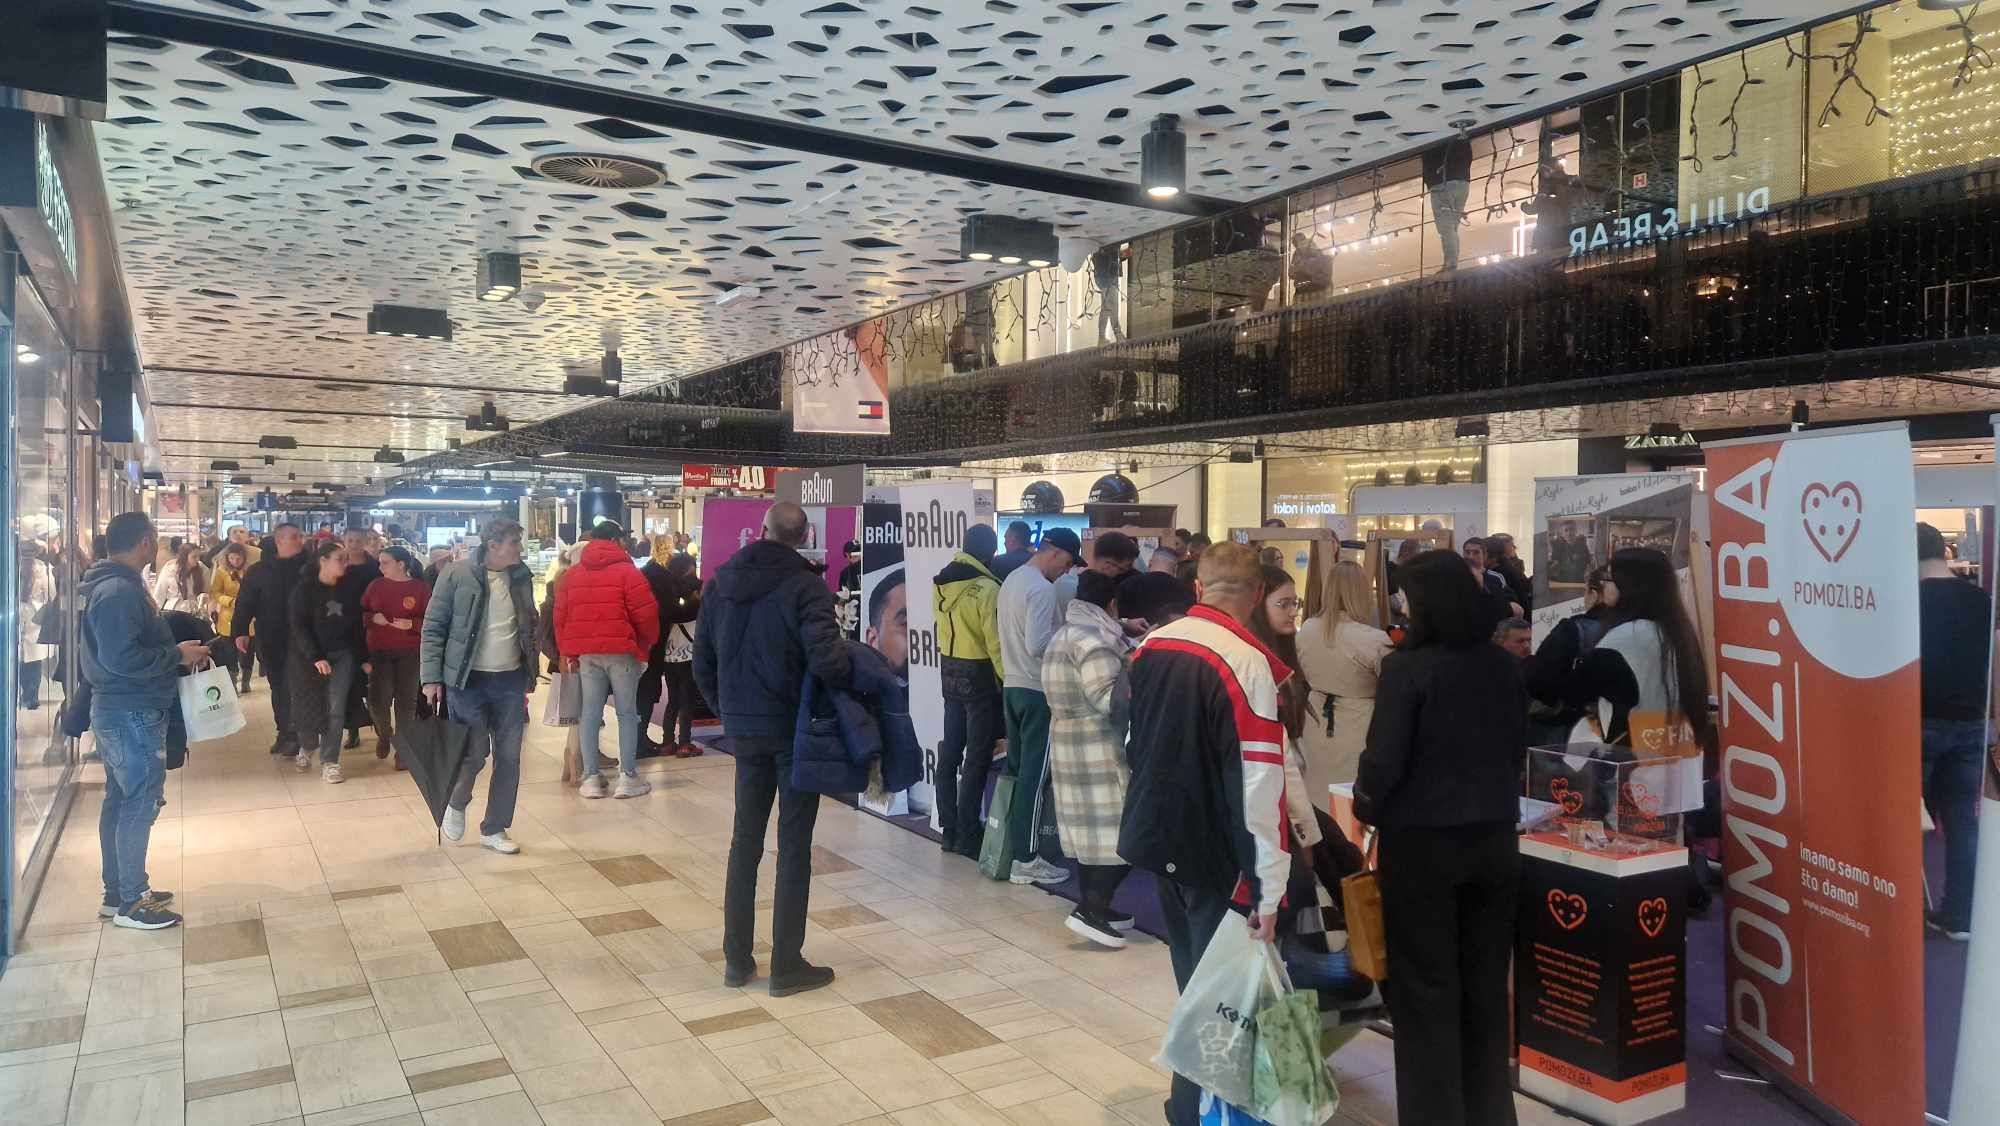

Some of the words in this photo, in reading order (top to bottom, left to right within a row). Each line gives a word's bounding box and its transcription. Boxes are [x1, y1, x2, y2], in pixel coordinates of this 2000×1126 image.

[801, 472, 833, 503] BRAUN
[865, 522, 903, 544] BRAU
[905, 499, 968, 548] BRAUN
[1793, 581, 1877, 611] POMOZI.BA
[1713, 456, 1796, 1067] POMOZI.BA
[1799, 841, 1836, 873] Imamo
[1838, 862, 1870, 886] samo
[1873, 876, 1897, 898] ono
[1800, 868, 1818, 891] što
[1822, 878, 1859, 909] damo!
[1538, 1056, 1593, 1087] POMOZI.BA
